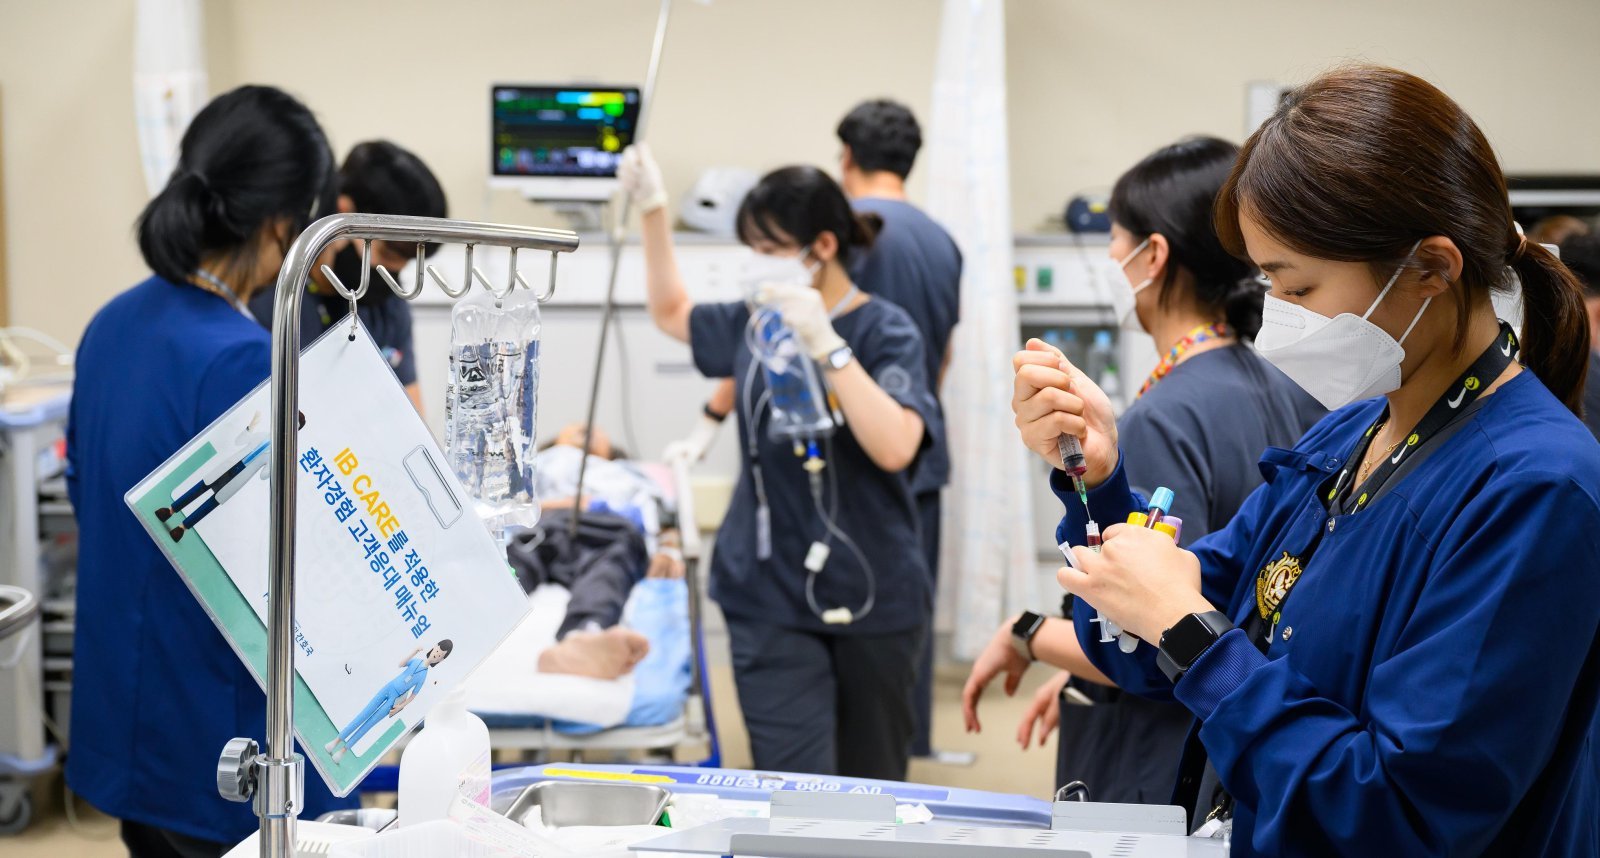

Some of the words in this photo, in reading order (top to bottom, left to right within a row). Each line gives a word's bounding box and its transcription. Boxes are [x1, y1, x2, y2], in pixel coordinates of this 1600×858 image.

[299, 446, 357, 523] 환자경험
[348, 519, 402, 591] 고객응대
[394, 584, 431, 639] 매뉴얼
[334, 447, 358, 476] IB
[352, 474, 409, 554] CARE를
[404, 548, 440, 603] 적용한
[295, 632, 314, 657] 간호국
